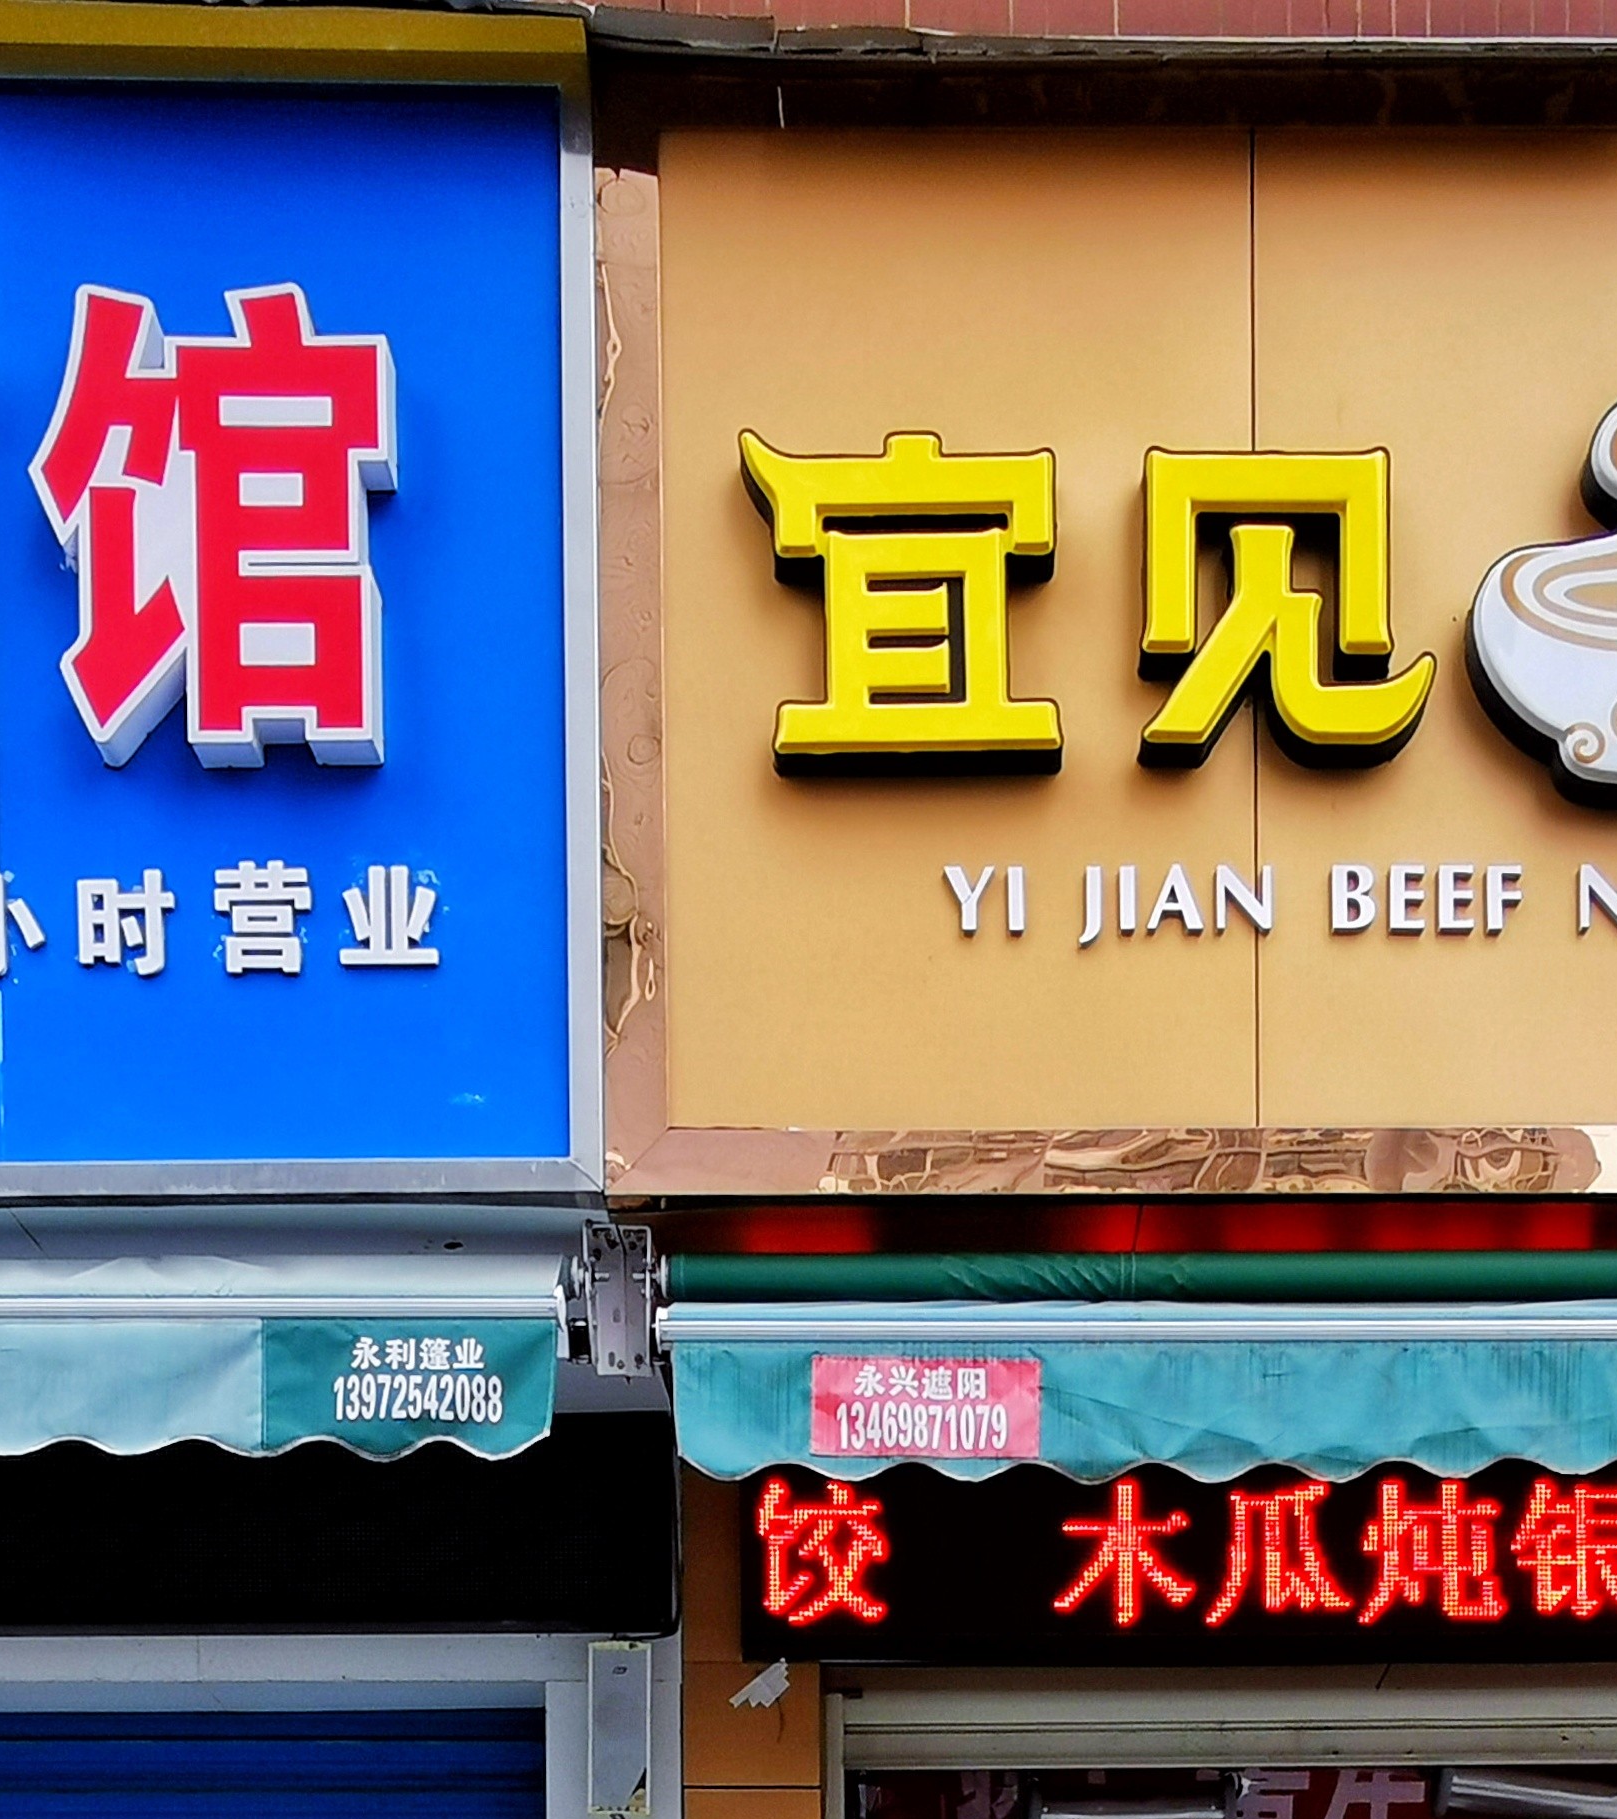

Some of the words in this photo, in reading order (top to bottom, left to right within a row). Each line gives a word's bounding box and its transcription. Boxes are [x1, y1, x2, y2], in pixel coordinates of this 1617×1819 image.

[942, 864, 1026, 937] YI
[1077, 864, 1275, 949] JIAN
[1328, 862, 1523, 936] BEEF
[350, 1336, 485, 1371] 永利篷业
[332, 1374, 504, 1424] 13972542088
[852, 1364, 987, 1400] 永兴遮阳
[835, 1400, 1009, 1452] 13469871079
[757, 1481, 889, 1626] 饺
